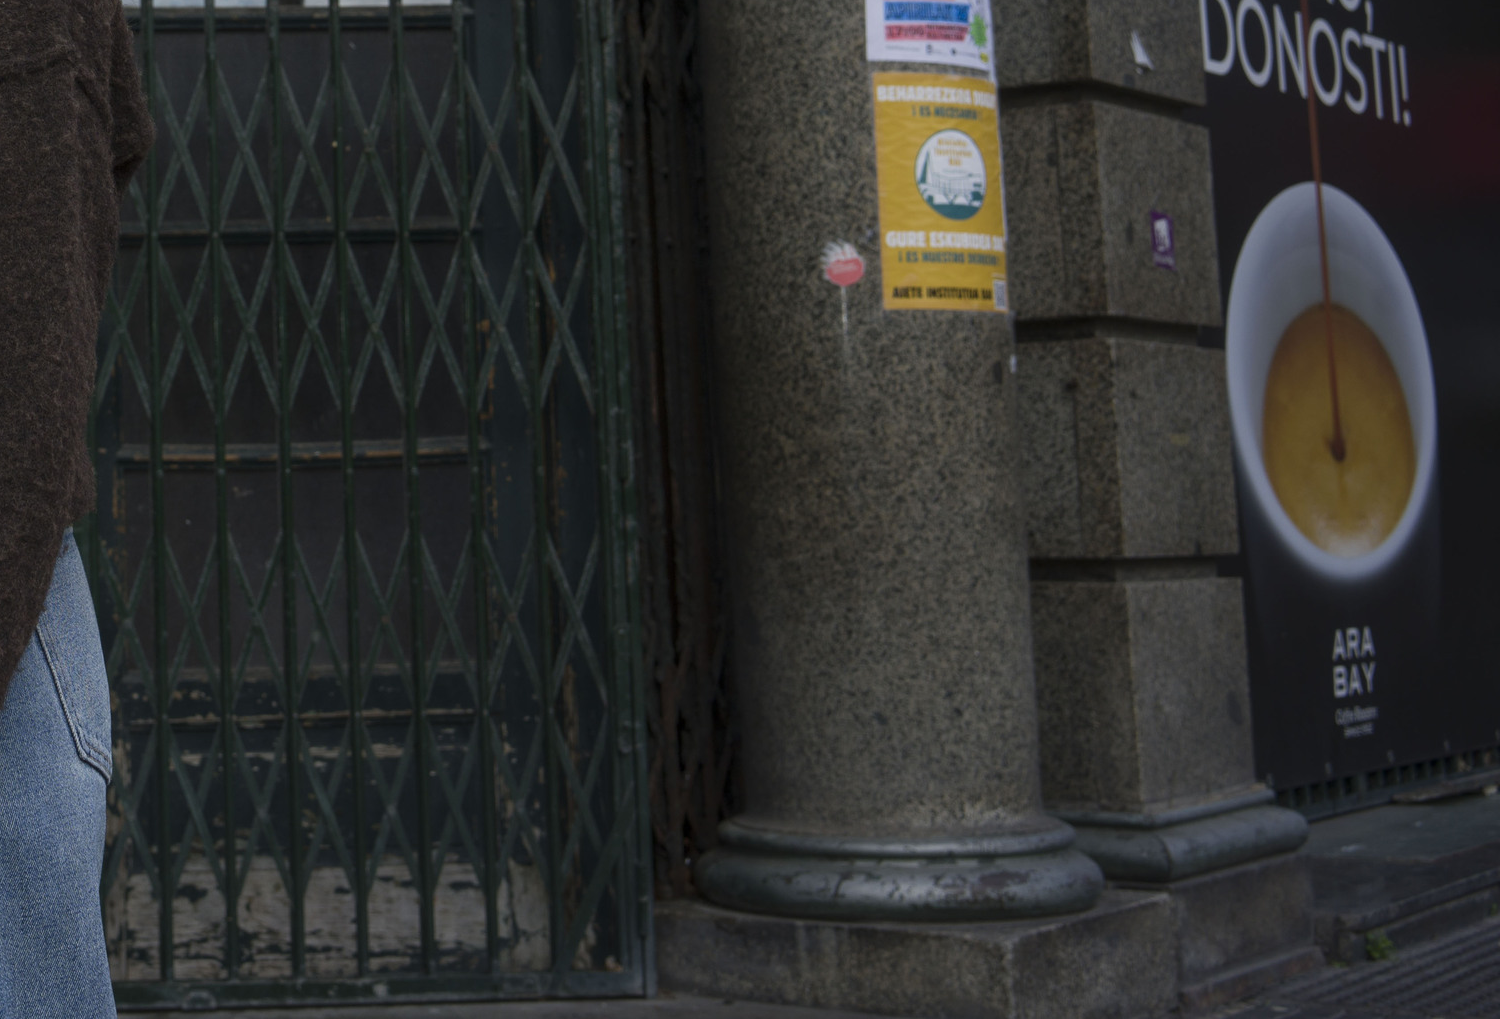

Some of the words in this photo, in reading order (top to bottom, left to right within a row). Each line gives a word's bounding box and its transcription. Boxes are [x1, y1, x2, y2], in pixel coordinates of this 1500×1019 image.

[885, 231, 927, 249] GURE
[1332, 626, 1376, 662] ARA
[1332, 661, 1377, 699] BAY
